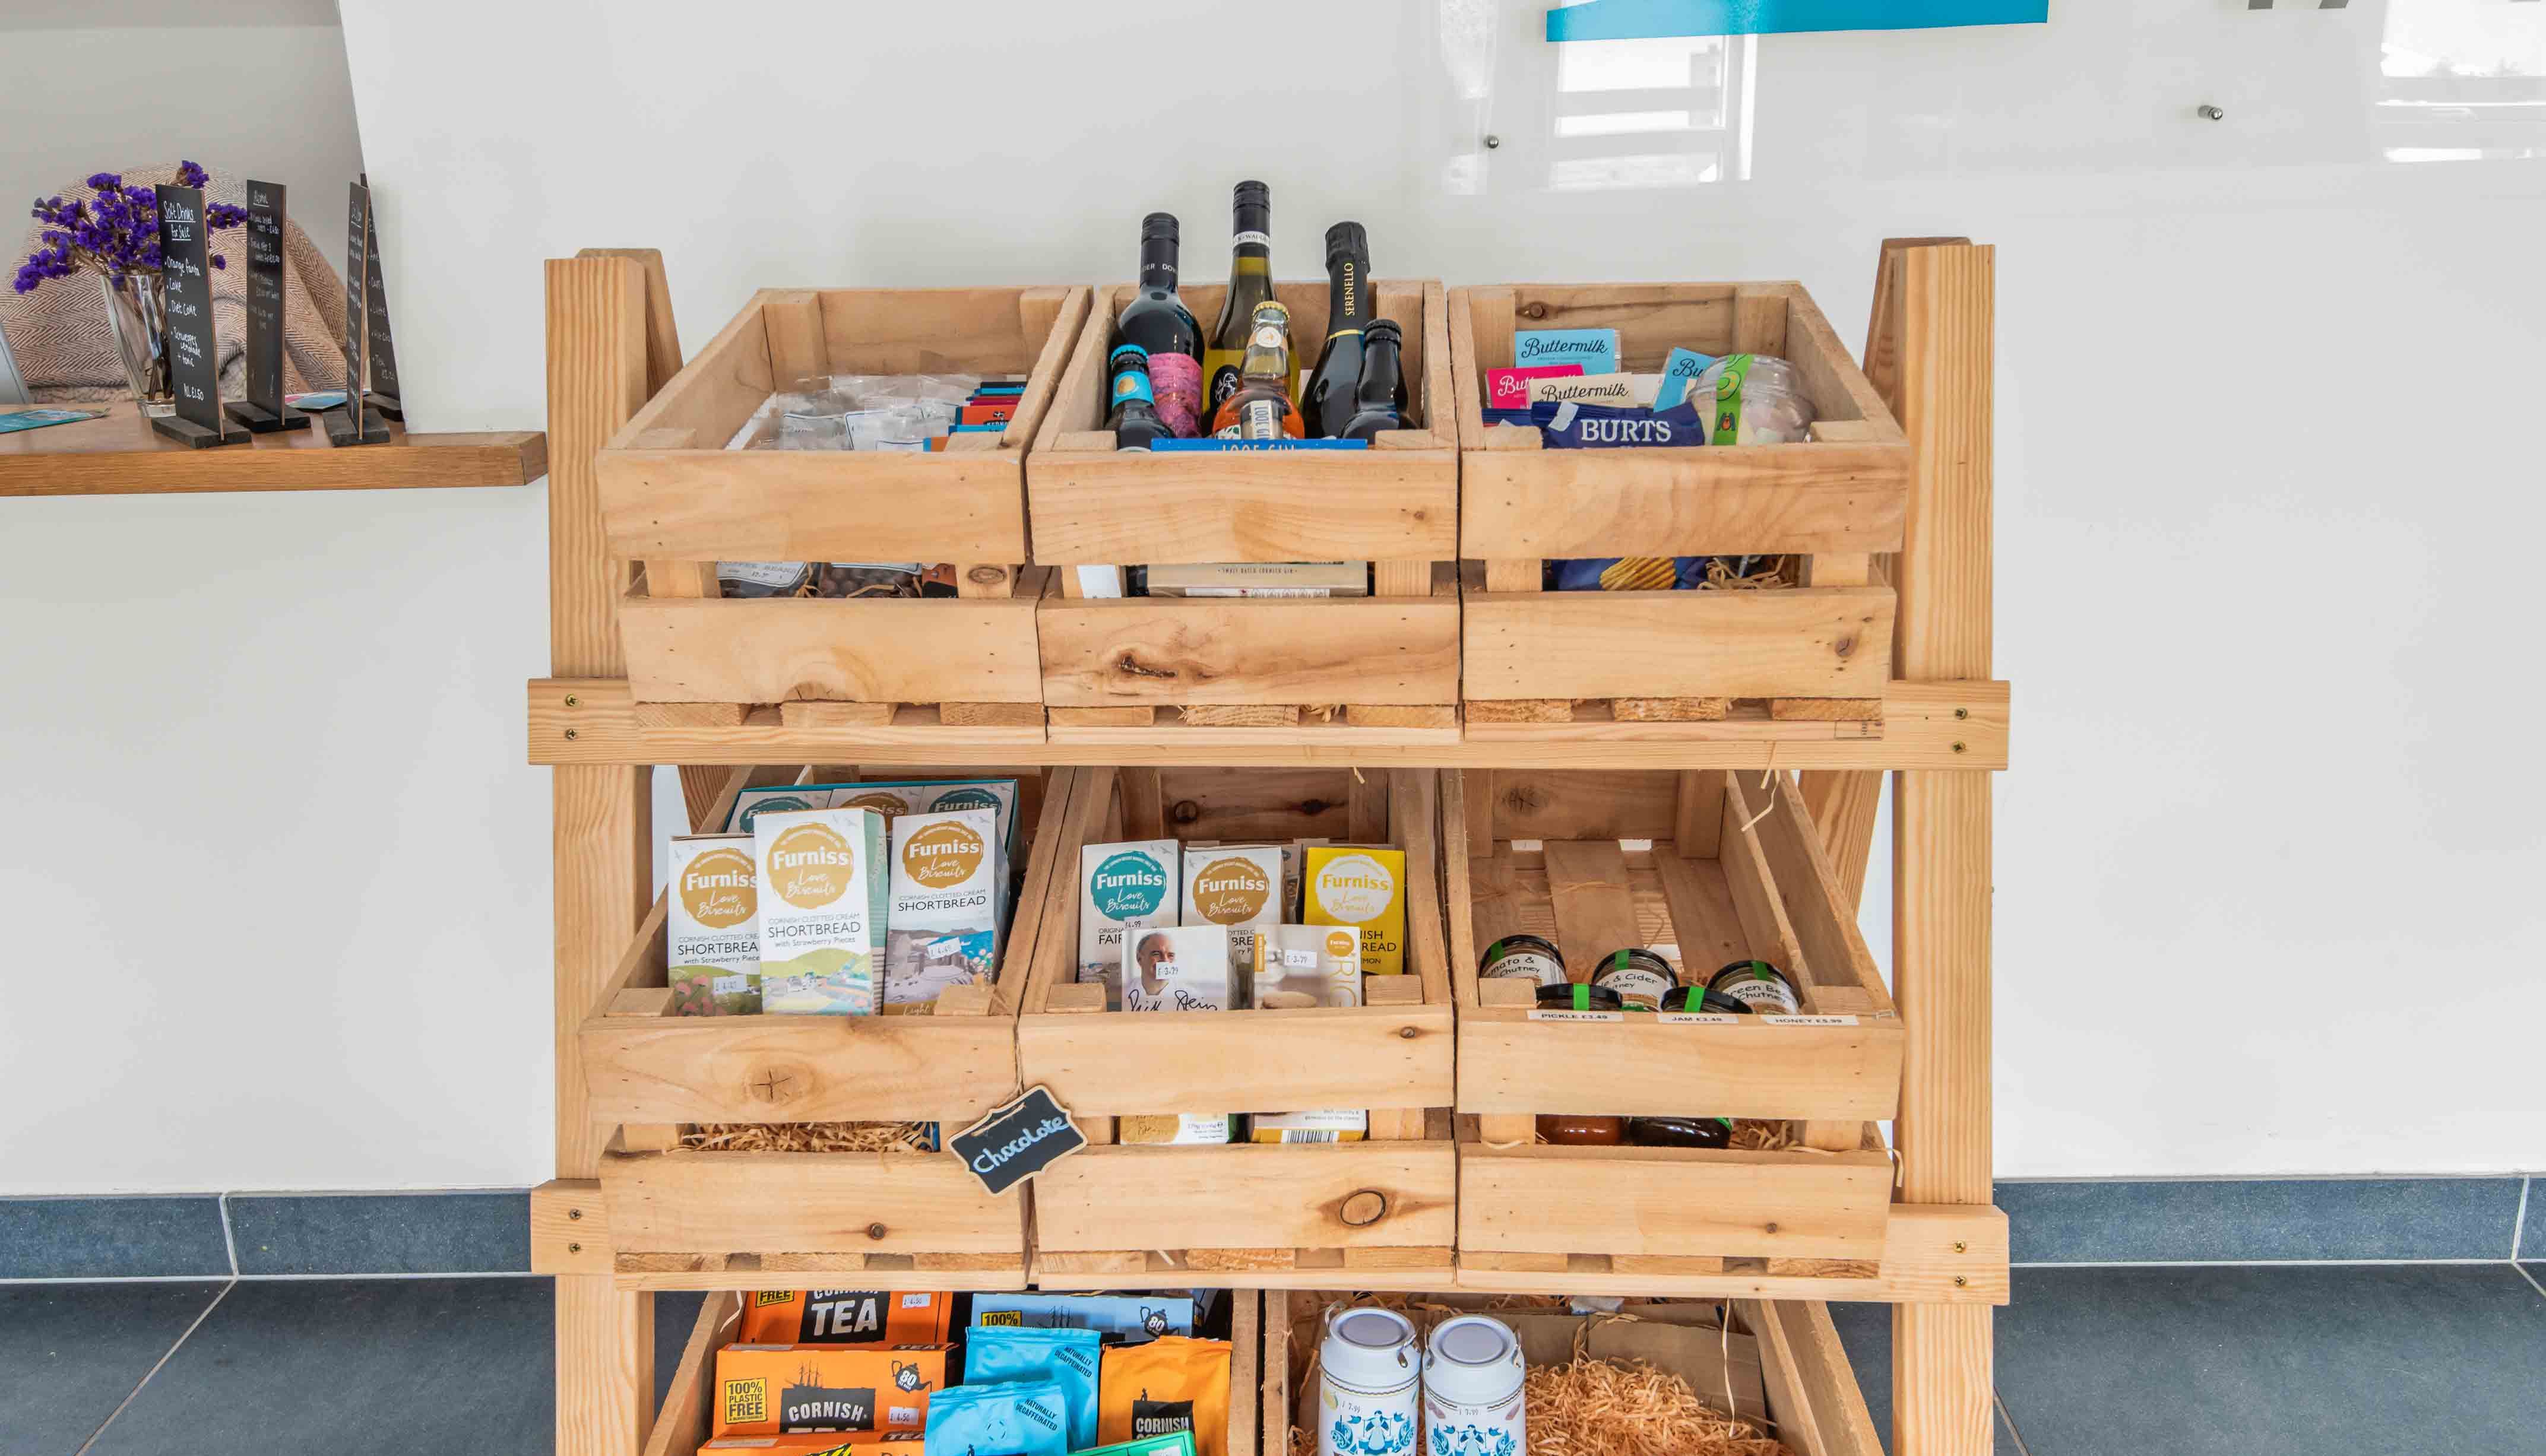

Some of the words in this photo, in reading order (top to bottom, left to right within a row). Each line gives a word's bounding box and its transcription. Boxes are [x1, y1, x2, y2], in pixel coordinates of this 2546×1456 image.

[163, 200, 178, 220] Soft
[177, 202, 194, 221] Drinks
[179, 224, 191, 239] Sale
[169, 278, 182, 293] Coke
[1344, 262, 1356, 316] SERENELLO
[171, 300, 182, 315] Diet
[183, 303, 197, 316] Coke
[1521, 337, 1608, 359] Buttermilk
[1539, 383, 1629, 403] Buttermilk
[1579, 419, 1672, 442] BURTS
[909, 839, 979, 859] Furniss
[773, 845, 850, 871] Furniss
[931, 856, 960, 871] Love
[919, 865, 967, 880] Biscuits
[1096, 870, 1163, 890] Furniss
[1198, 875, 1265, 894] Furniss
[1322, 873, 1389, 891] Furniss
[710, 890, 740, 907] Love
[930, 892, 962, 900] CLOTTED
[963, 888, 987, 897] CREAM
[1117, 888, 1144, 903] Love
[1220, 892, 1246, 906] Love
[898, 895, 987, 912] SHORTBREAD
[1106, 898, 1151, 913] Biscuits
[1207, 902, 1253, 916] Biscuits
[767, 921, 861, 938] SHORTBREAD
[792, 938, 832, 947] Strawberry
[701, 956, 740, 965] Strawberry
[1499, 966, 1541, 978] Chutney
[1613, 975, 1622, 983] &
[1624, 973, 1658, 985] Cider
[1737, 991, 1787, 1004] Chutney
[973, 1116, 1070, 1173] Chocolate
[811, 1298, 878, 1336] TEA
[984, 1313, 1019, 1327] 100%
[1148, 1315, 1166, 1331] 80
[1054, 1349, 1093, 1378] DECAFFEINATED
[1063, 1346, 1093, 1366] NATURALLY
[899, 1370, 918, 1387] 80
[729, 1381, 763, 1395] 100%
[729, 1393, 763, 1403] PLASTIC
[729, 1401, 763, 1417] FREE
[787, 1401, 864, 1422] CORNISH
[1025, 1398, 1057, 1420] NATURALLY
[1015, 1404, 1058, 1432] DECAFFEINATED
[1135, 1416, 1189, 1433] CORNISH
